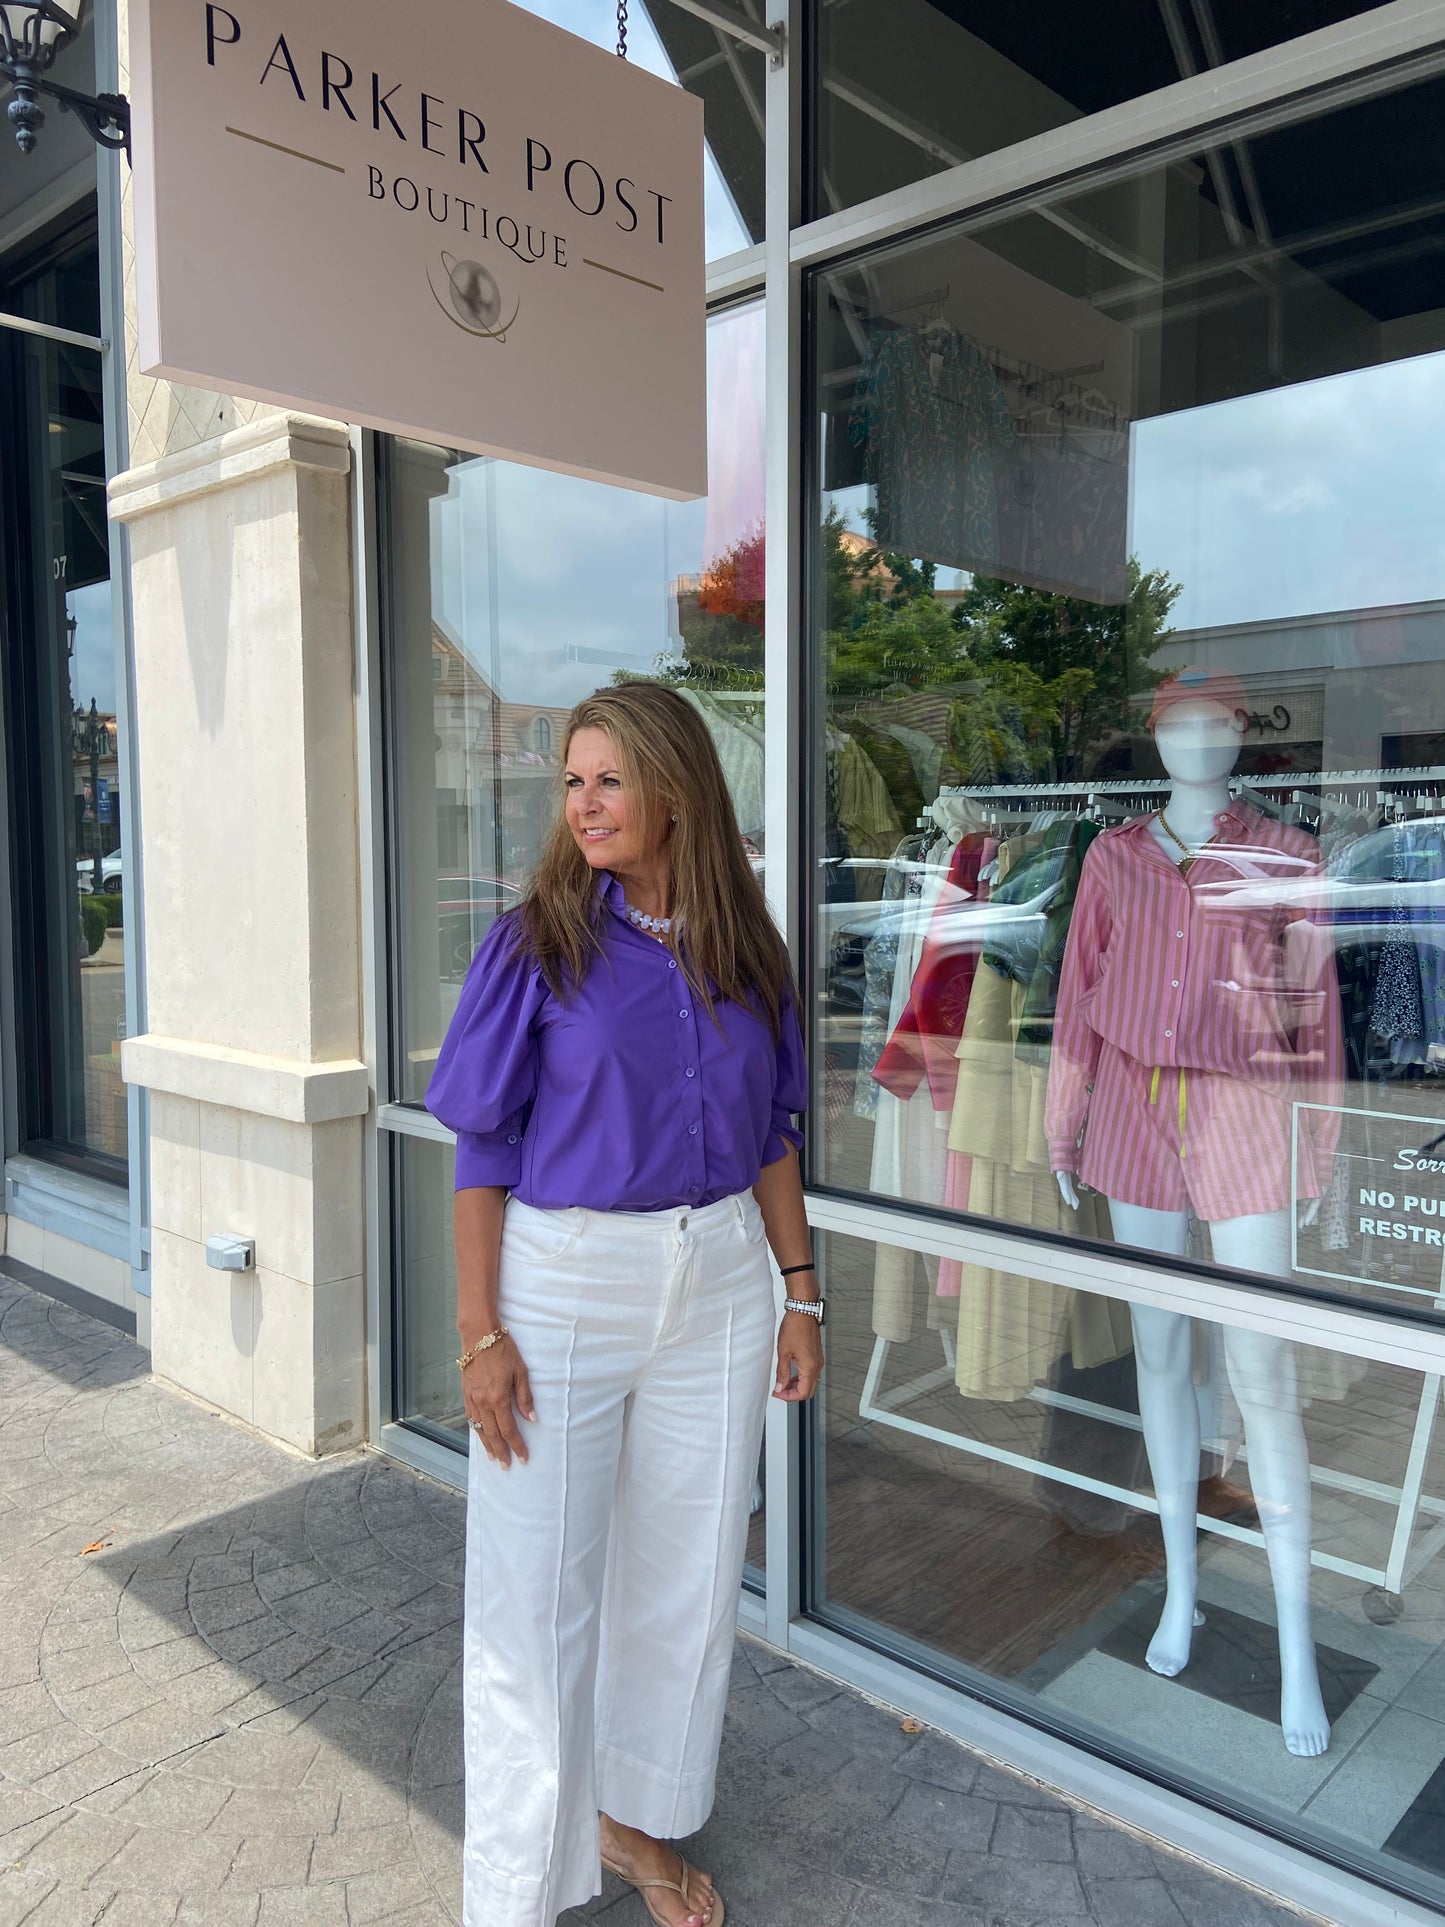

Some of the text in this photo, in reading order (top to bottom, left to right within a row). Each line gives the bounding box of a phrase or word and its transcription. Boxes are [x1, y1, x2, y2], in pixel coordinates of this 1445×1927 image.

[205, 3, 673, 244] PARKER POST
[367, 164, 569, 268] BOUTIQUE
[1360, 1188, 1395, 1209] NO
[1360, 1217, 1445, 1246] RESTR
